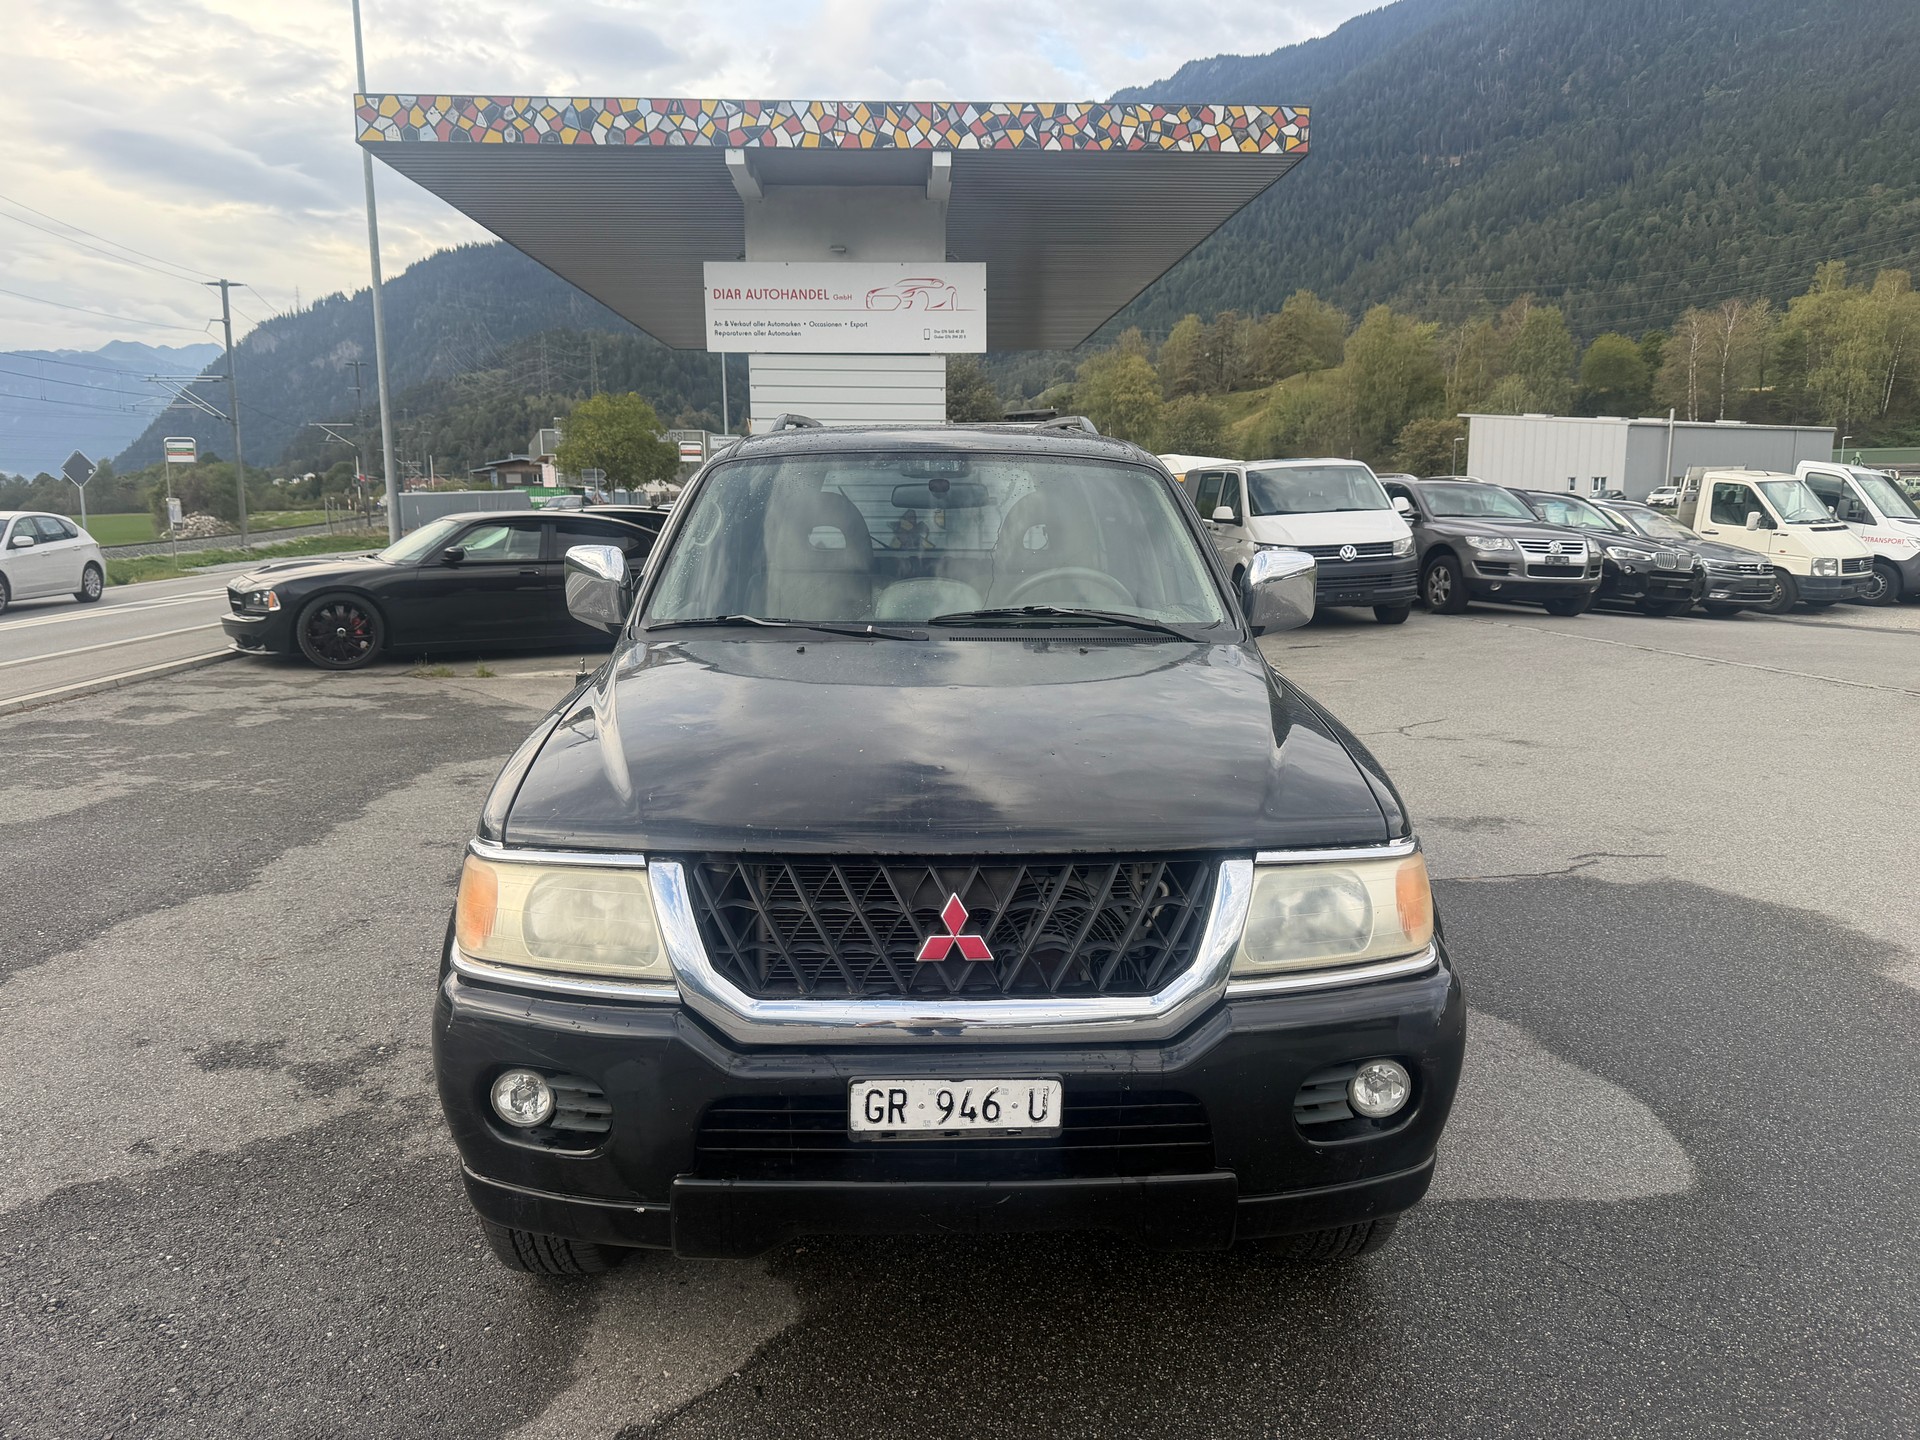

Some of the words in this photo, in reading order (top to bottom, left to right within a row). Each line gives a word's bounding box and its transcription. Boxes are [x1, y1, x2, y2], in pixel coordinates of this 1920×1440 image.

[713, 288, 742, 300] DIAR
[745, 288, 830, 300] AUTOHANDEL
[850, 321, 868, 329] Export
[714, 330, 752, 338] Reparaturen
[864, 1087, 908, 1124] GR
[936, 1087, 1001, 1125] 946
[1028, 1087, 1050, 1123] U
